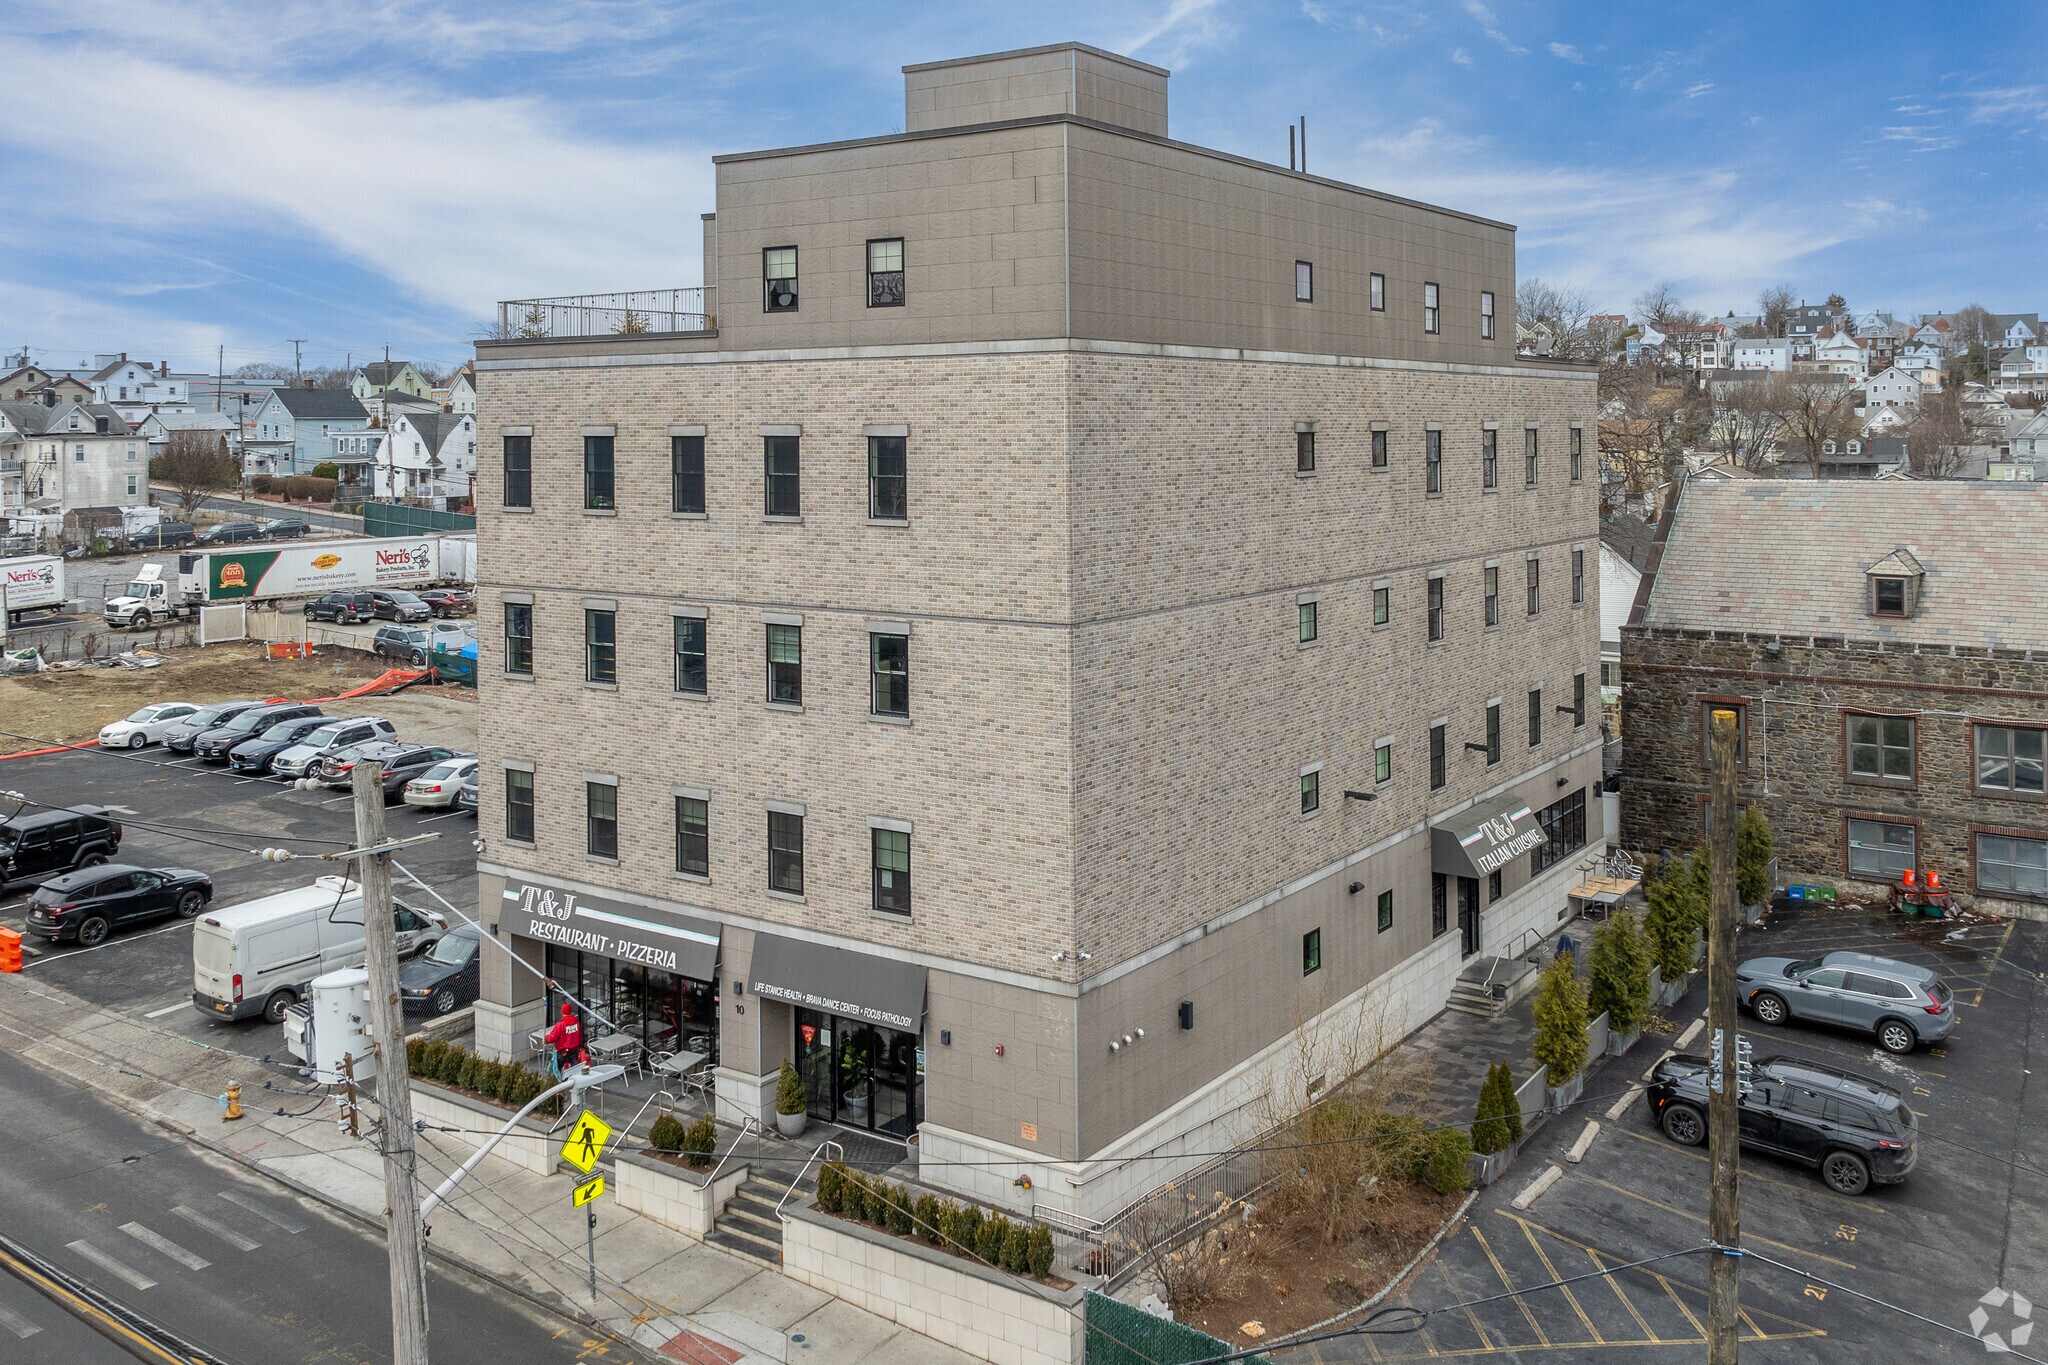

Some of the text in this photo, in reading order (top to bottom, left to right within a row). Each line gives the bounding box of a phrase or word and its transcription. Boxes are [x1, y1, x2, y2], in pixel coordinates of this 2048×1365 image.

[375, 548, 410, 565] Neri's
[7, 569, 37, 583] Neri's
[296, 572, 356, 582] www.nerisbakery.com
[1478, 812, 1516, 846] T&J
[1477, 828, 1543, 873] ITALIAN CUISINE
[520, 885, 577, 921] T&J
[529, 919, 677, 970] RESTAURANT PIZZERIA
[735, 1004, 745, 1015] 10
[754, 982, 913, 1028] LIFE STANCE HEALTH BRAVA DANCE CENTER FOCUS PATHOLOGY
[1803, 1284, 1828, 1301] 21
